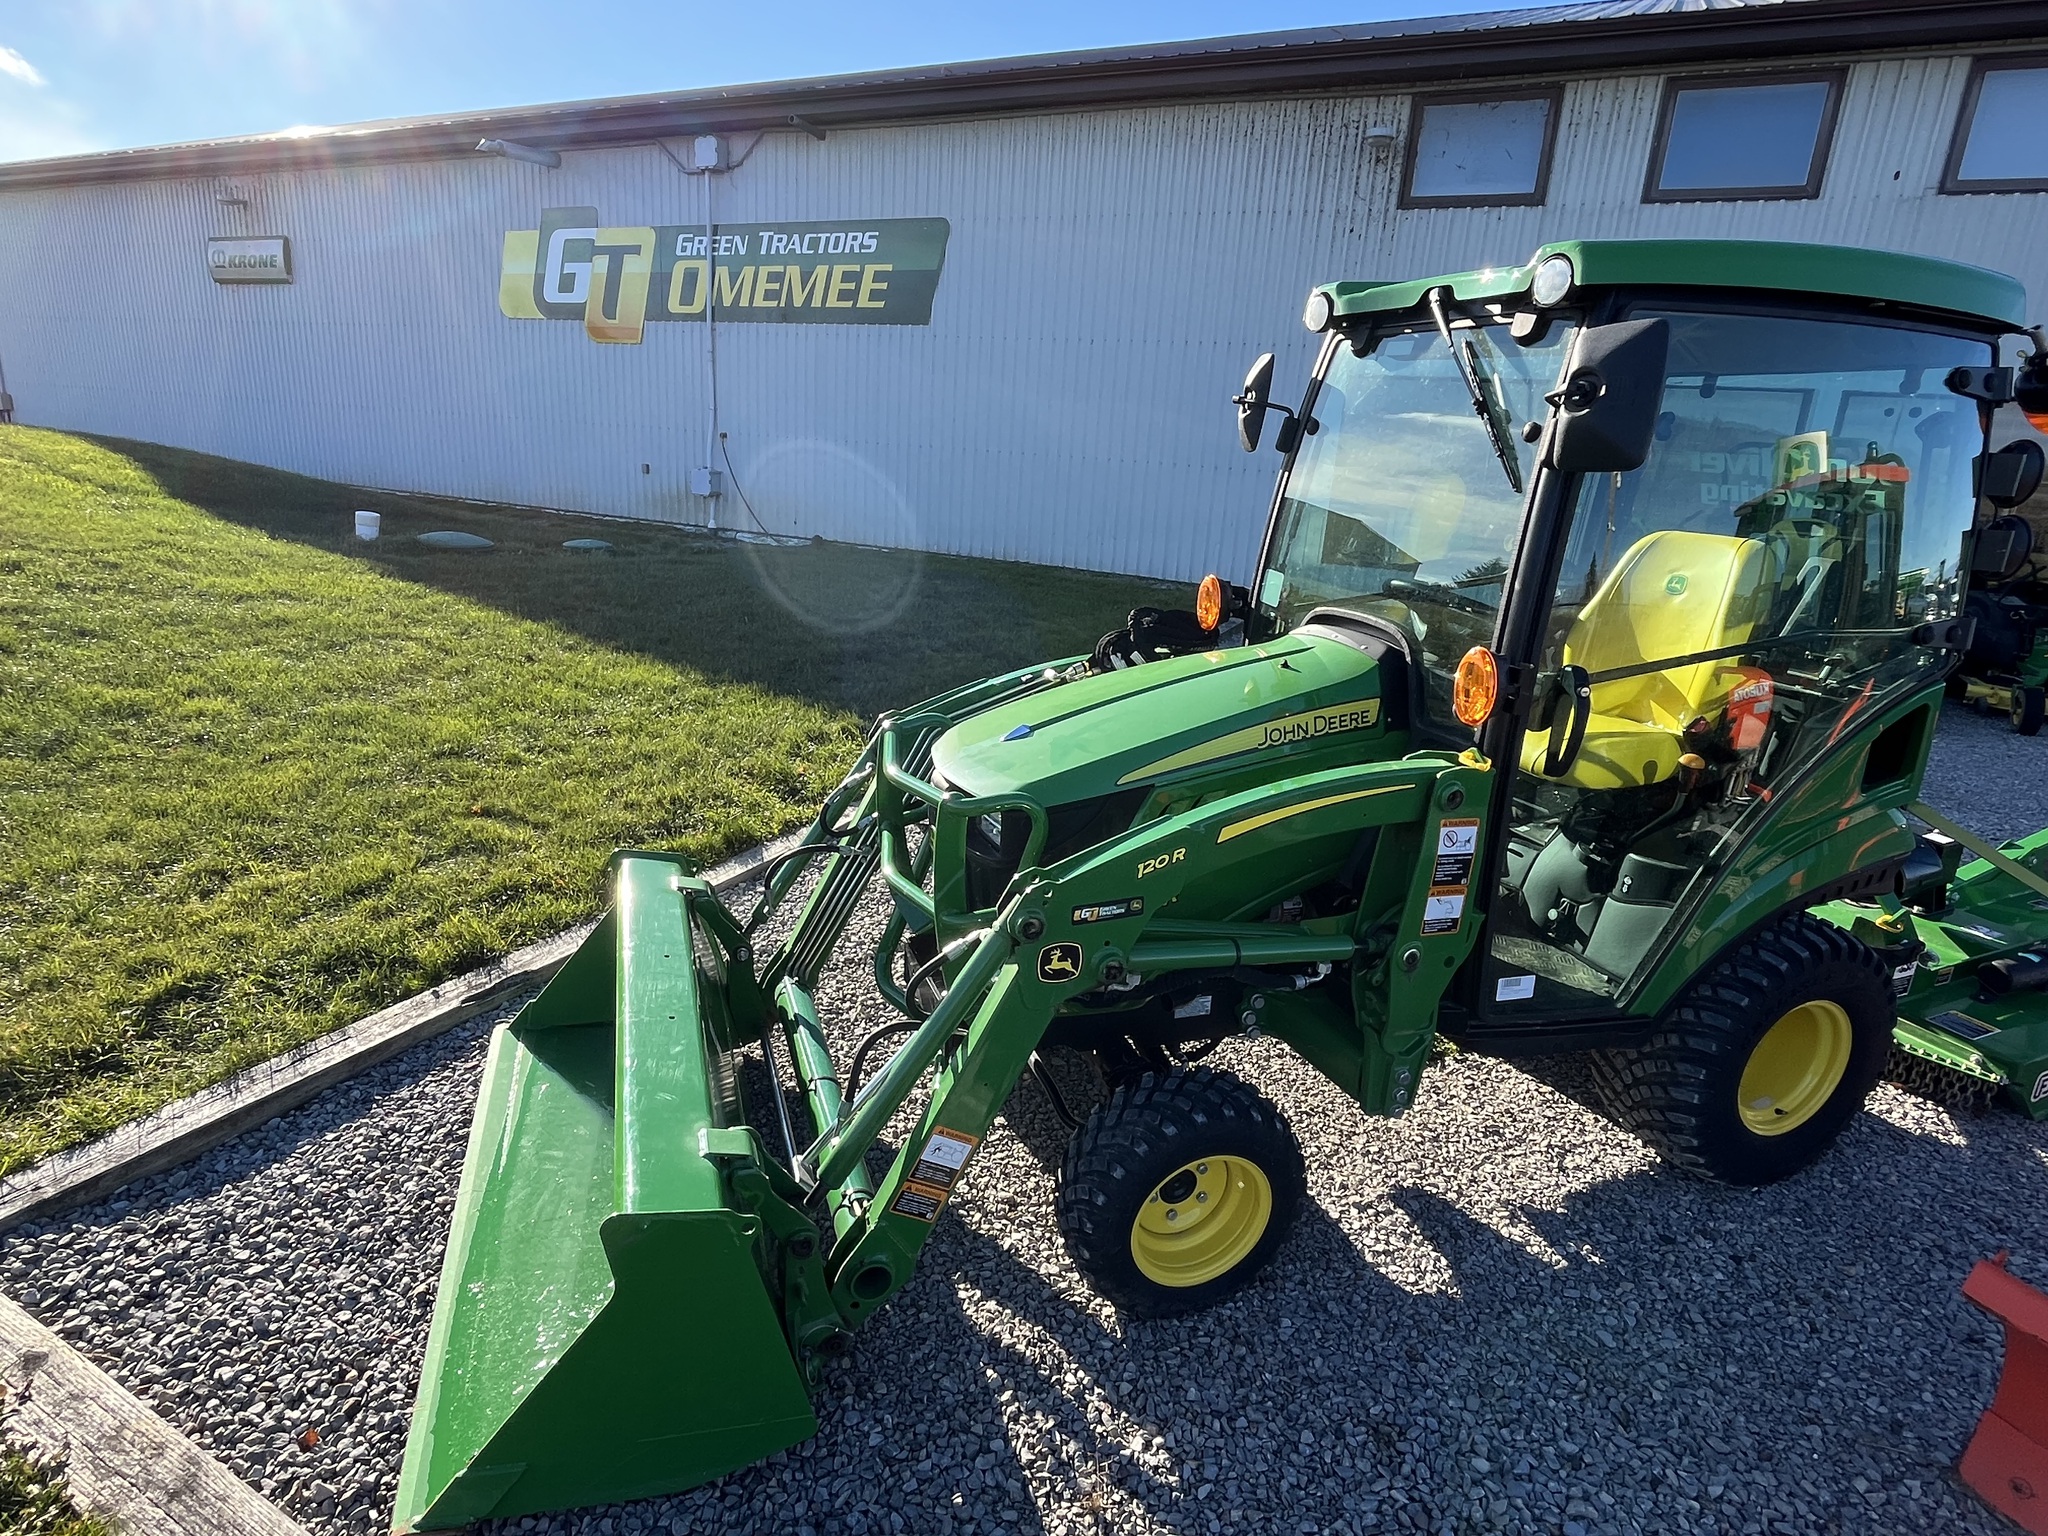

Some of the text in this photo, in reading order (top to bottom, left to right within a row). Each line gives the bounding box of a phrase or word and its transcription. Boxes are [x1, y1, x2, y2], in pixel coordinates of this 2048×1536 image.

[227, 254, 278, 269] KRONE
[675, 231, 879, 256] GREEN TRACTORS
[543, 228, 642, 322] GT
[667, 259, 893, 314] OMEMEE
[1258, 710, 1371, 747] JOHN DEERE
